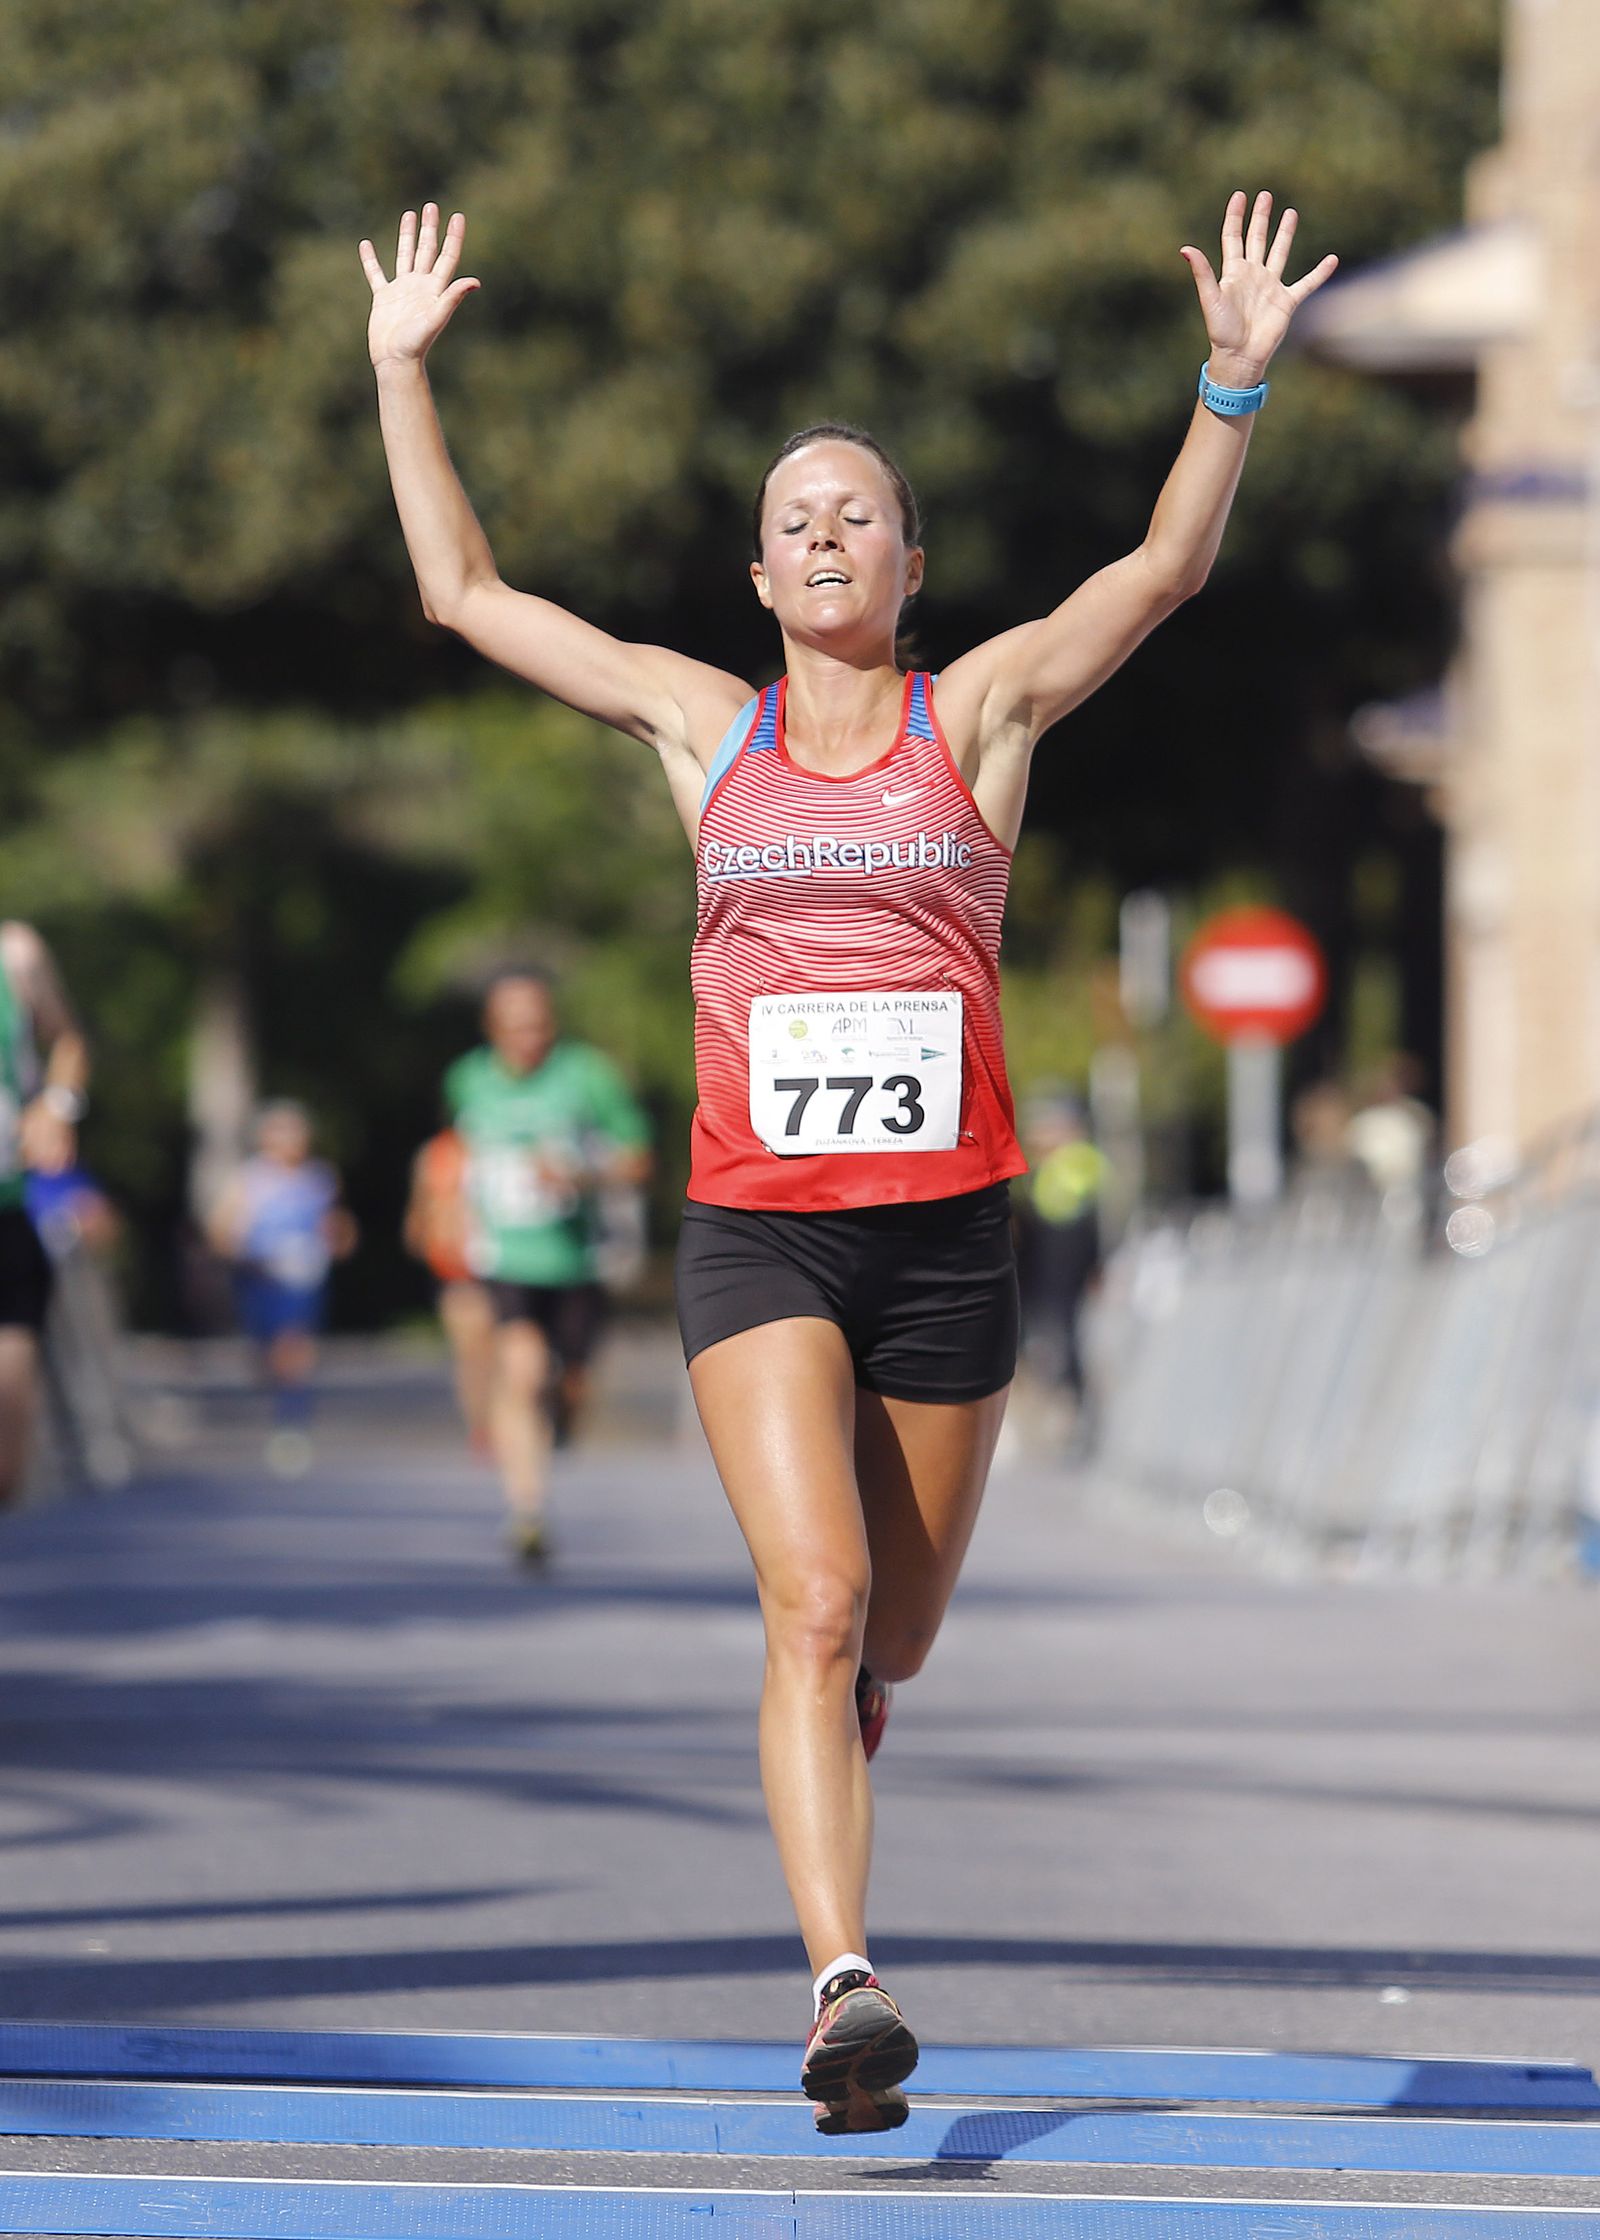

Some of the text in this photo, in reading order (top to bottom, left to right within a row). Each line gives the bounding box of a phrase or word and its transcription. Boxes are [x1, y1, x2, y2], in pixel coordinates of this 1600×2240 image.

[704, 831, 972, 876] CzechRepublic
[761, 1000, 949, 1016] IV CARRERA DE LA PRENSA
[831, 1017, 868, 1034] APM
[774, 1075, 925, 1136] 773
